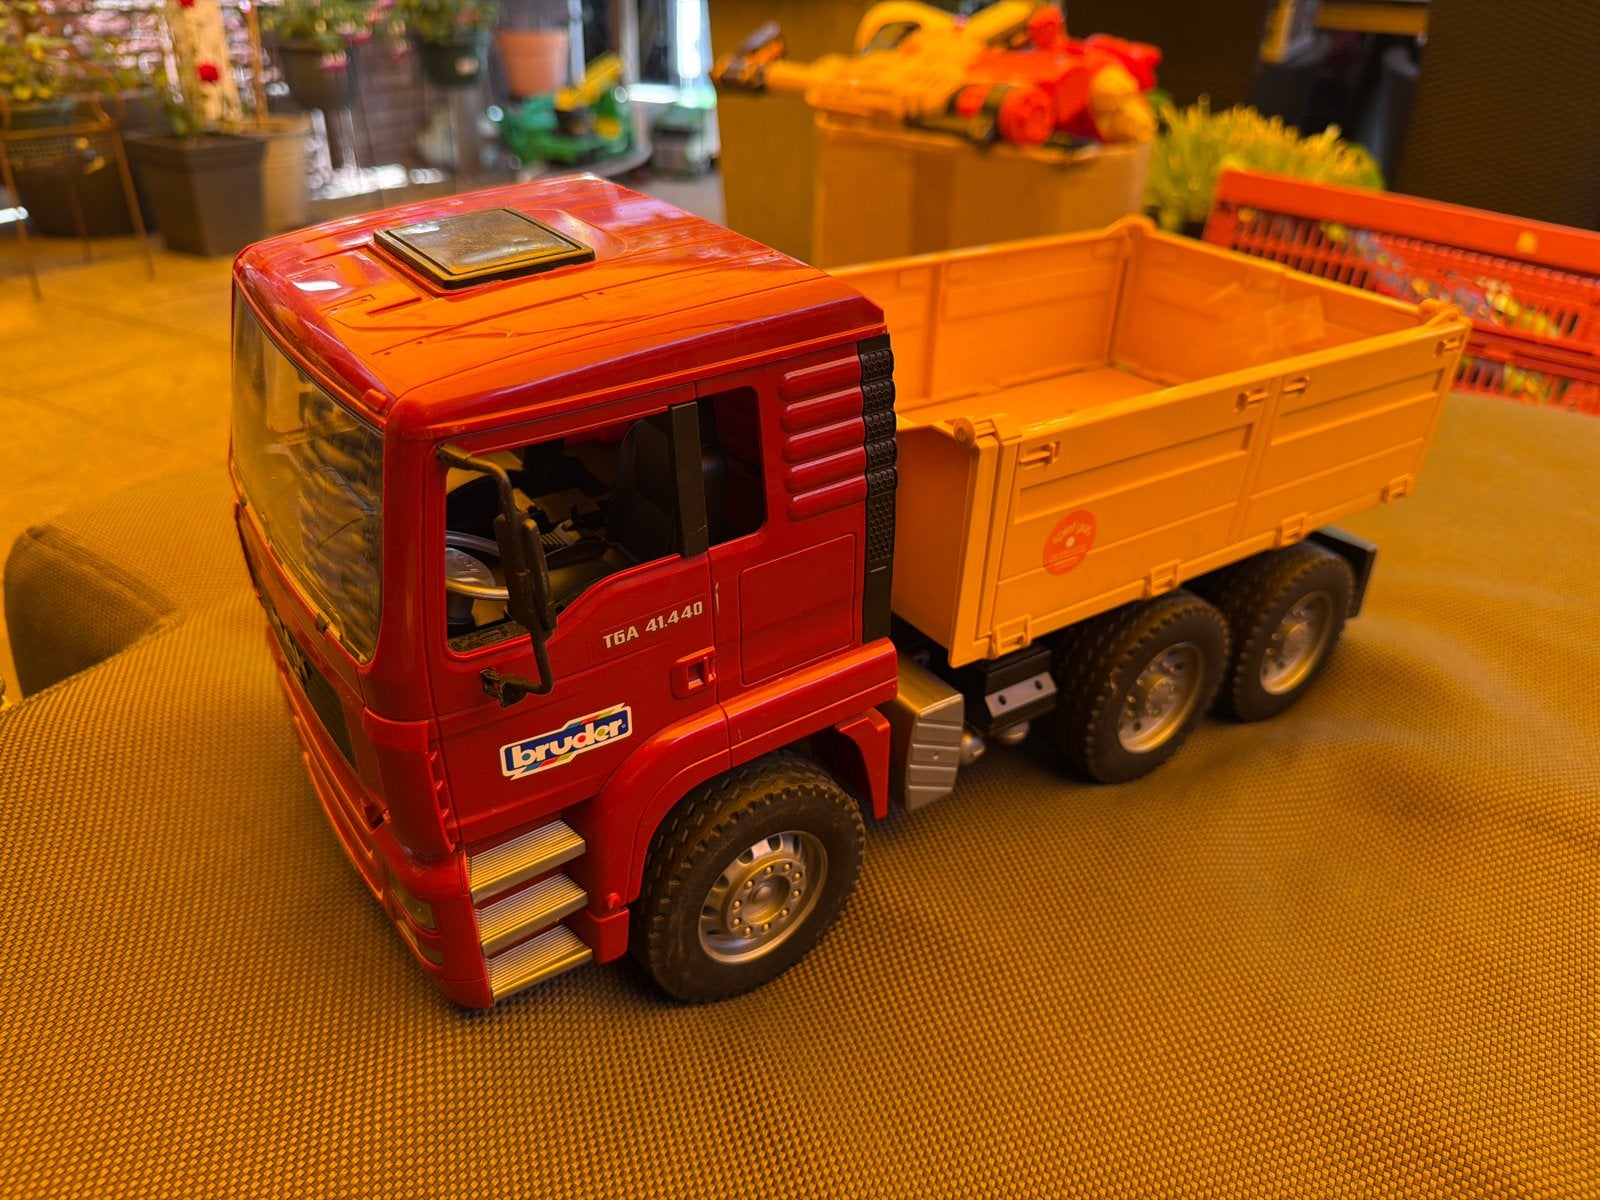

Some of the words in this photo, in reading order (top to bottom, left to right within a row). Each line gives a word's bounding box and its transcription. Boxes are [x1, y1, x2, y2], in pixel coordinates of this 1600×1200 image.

[603, 626, 639, 649] TGA
[645, 601, 703, 632] 41.440
[511, 718, 623, 769] bruder
